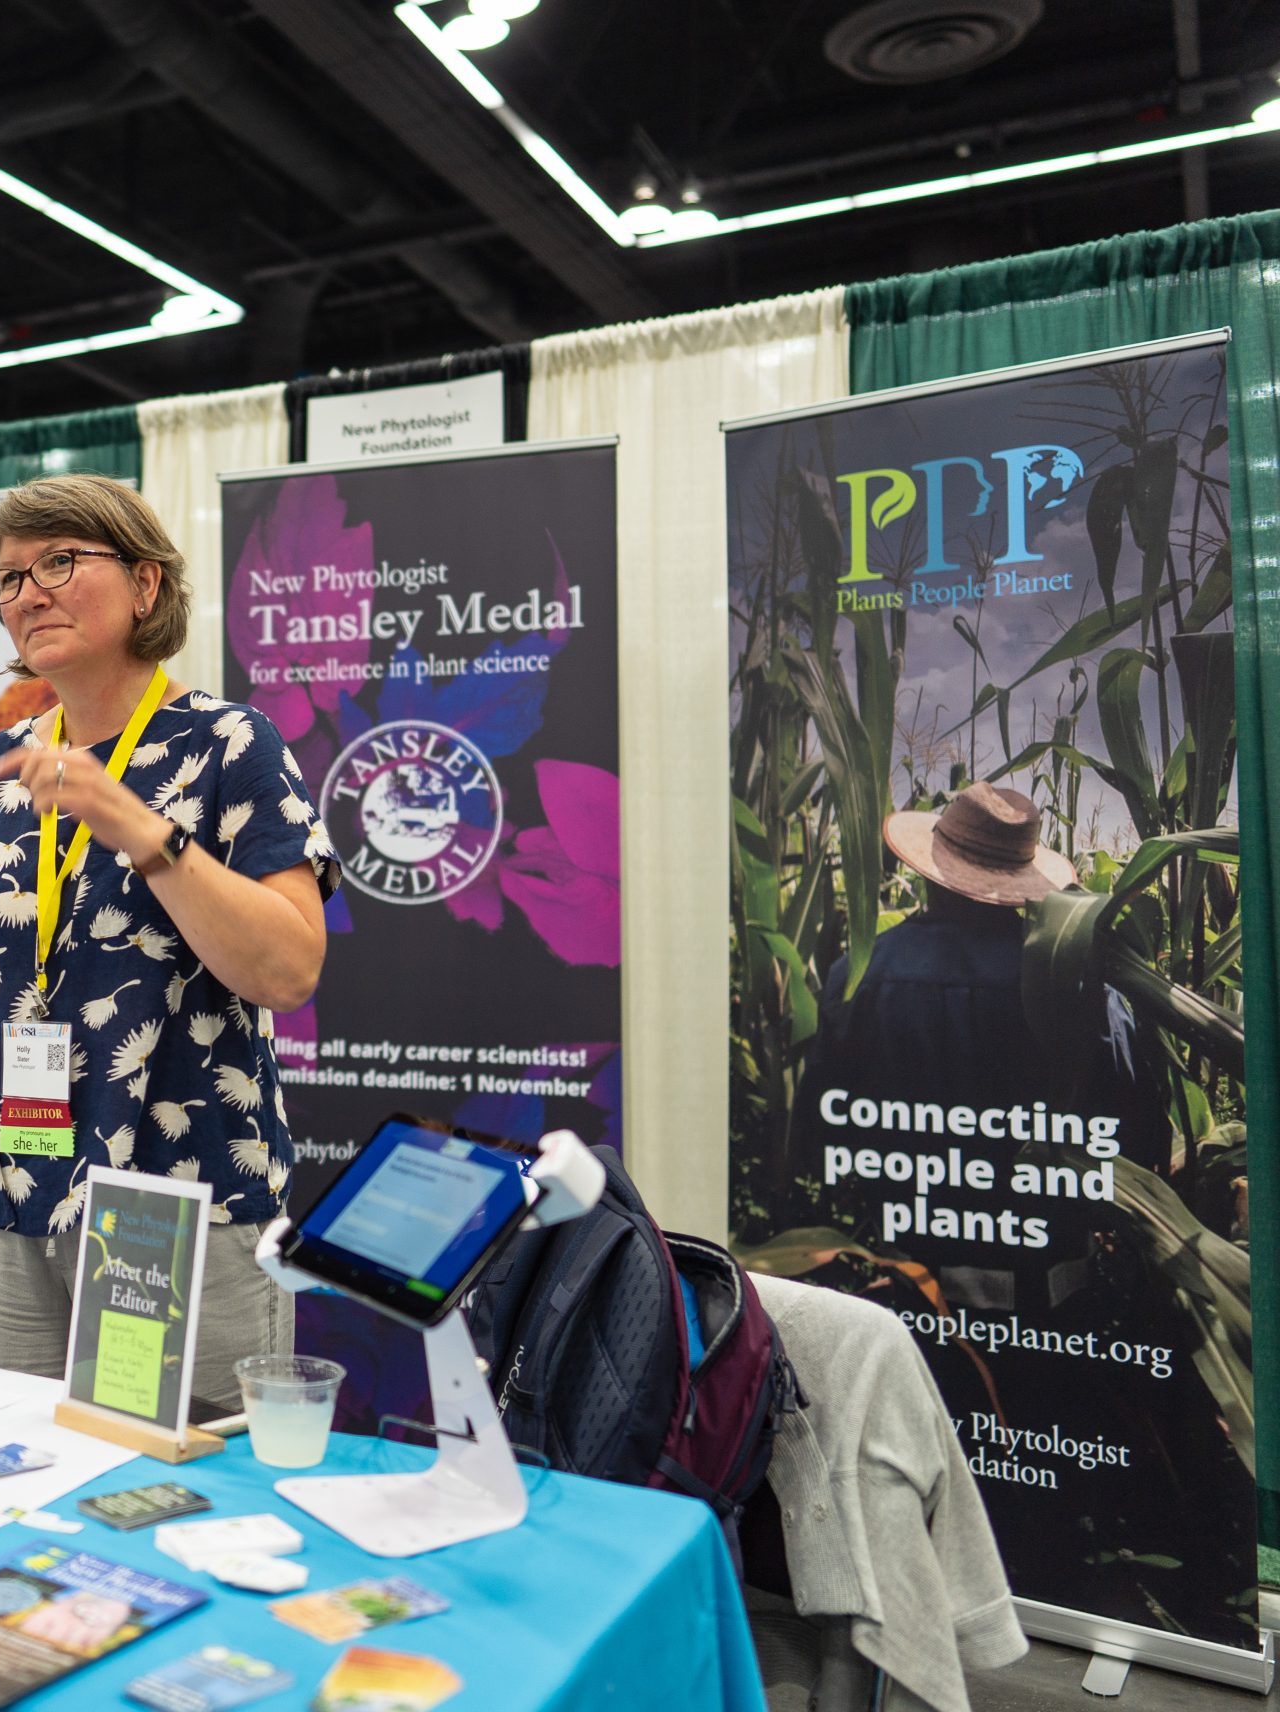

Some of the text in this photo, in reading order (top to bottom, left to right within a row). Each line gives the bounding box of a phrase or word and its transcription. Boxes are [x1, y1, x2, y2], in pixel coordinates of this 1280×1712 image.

[342, 411, 470, 437] New Phytologist
[361, 435, 452, 454] Foundation
[249, 559, 448, 597] New Phytologist
[836, 569, 1073, 613] Plants People Planet
[249, 585, 584, 649] Tansley Medal
[250, 651, 551, 685] for excellence in plant science
[332, 730, 491, 801] TANSLEY
[347, 844, 483, 895] MEDAL
[274, 1038, 587, 1068] lling all early career scientists!
[278, 1066, 591, 1098] mission deadline: 1 November
[8, 1107, 64, 1119] EXHIBITOR
[820, 1088, 1120, 1158] Connecting
[293, 1136, 361, 1165] phytol
[824, 1145, 1115, 1202] people and
[882, 1196, 1049, 1249] plants
[104, 1254, 170, 1289] Meet the
[110, 1284, 159, 1315] Editor
[899, 1308, 1173, 1379] eopleplanet.org
[970, 1411, 1131, 1471] Phytologist
[969, 1447, 1059, 1490] dation
